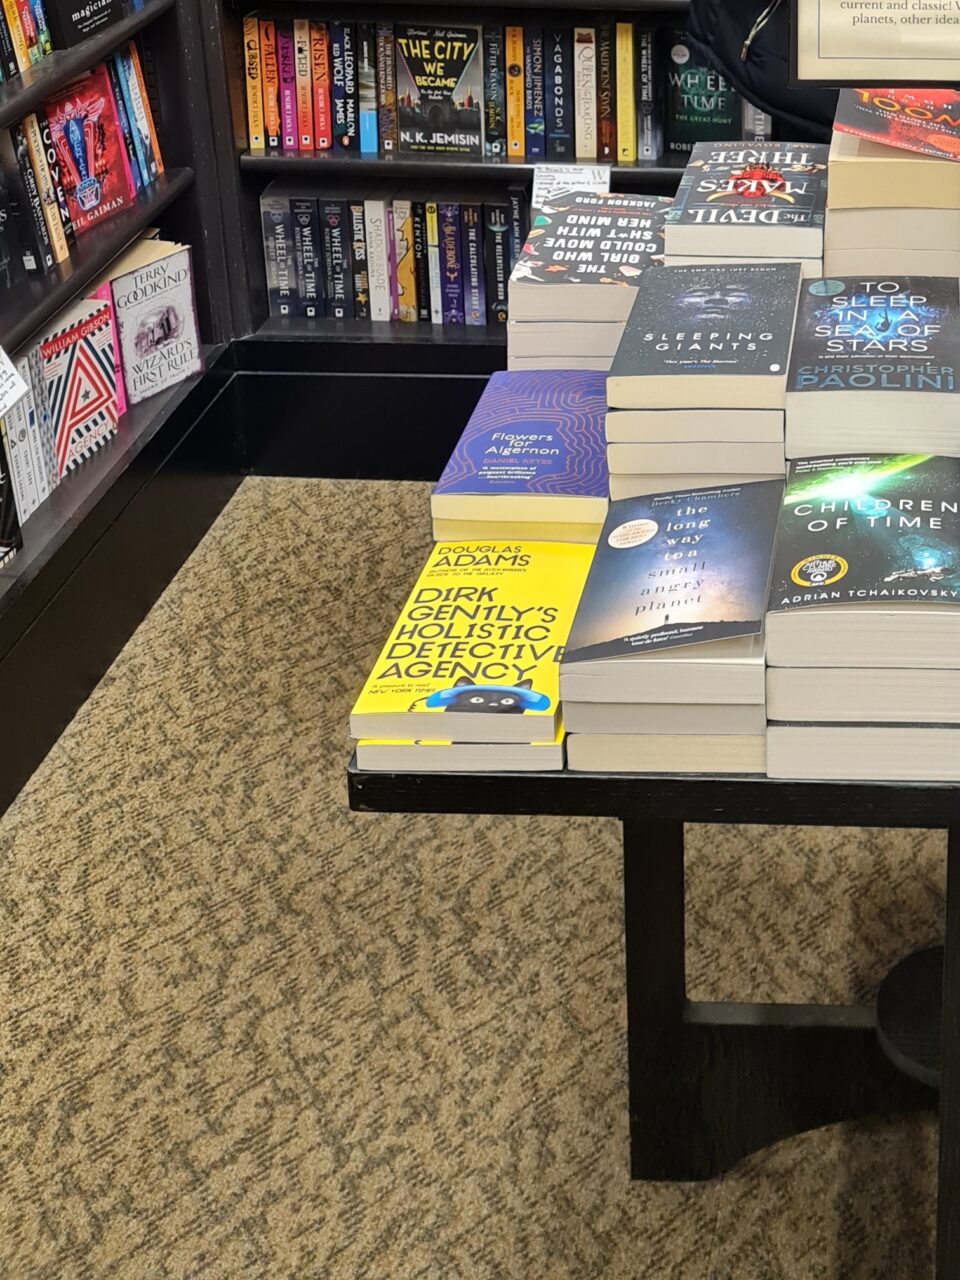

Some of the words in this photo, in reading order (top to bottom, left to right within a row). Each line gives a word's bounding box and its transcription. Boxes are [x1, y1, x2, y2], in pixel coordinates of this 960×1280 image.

[840, 0, 882, 10] current
[886, 0, 907, 11] and
[912, 0, 951, 11] classic!
[852, 14, 897, 26] planets,
[900, 15, 931, 24] other
[398, 38, 430, 58] THE
[434, 40, 475, 60] CITY
[423, 62, 444, 76] WE
[415, 76, 457, 88] BECAME
[710, 152, 813, 164] THREE
[698, 179, 808, 194] MAKES
[575, 196, 604, 205] FORD
[617, 197, 656, 207] JACKSON
[566, 214, 607, 227] MIND
[688, 209, 777, 223] DEVIL
[783, 212, 806, 222] The
[630, 218, 651, 228] HER
[556, 226, 601, 238] WITH
[544, 238, 594, 250] MOVE
[602, 239, 657, 253] COULD
[553, 251, 593, 262] WHO
[604, 252, 640, 264] GIRL
[576, 264, 606, 273] THE
[116, 269, 188, 308] GOODKIND
[860, 281, 900, 293] TO
[832, 296, 927, 308] SLEEP
[839, 309, 866, 321] IN
[900, 310, 921, 321] A
[814, 325, 876, 337] SEA
[898, 324, 941, 337] OF
[644, 333, 773, 341] SLEEPING
[656, 342, 757, 351] GIANTS
[826, 340, 929, 352] STARS
[798, 365, 954, 375] CHRISTOPHER
[797, 374, 955, 390] PAOLINI
[492, 432, 553, 441] Flowers
[509, 439, 532, 447] for
[485, 447, 559, 456] Algernon
[676, 505, 708, 516] the
[794, 499, 958, 516] CHILDREN
[666, 518, 711, 532] long
[807, 518, 848, 532] OF
[867, 517, 942, 529] TIME
[666, 534, 703, 546] way
[438, 546, 522, 555] DOUGLAS
[664, 551, 683, 561] to
[688, 550, 697, 558] a
[432, 554, 531, 567] ADAMS
[647, 561, 706, 579] small
[640, 579, 704, 596] angry
[414, 587, 498, 604] DIRK
[781, 591, 841, 605] ADRIAN
[848, 588, 958, 598] TCHAIKOVSKY
[635, 595, 702, 616] planet
[407, 604, 559, 623] GENTLY'S
[395, 622, 551, 641] HOLISTIC
[386, 641, 566, 663] DETECTIVE
[377, 660, 537, 681] AGENCY
